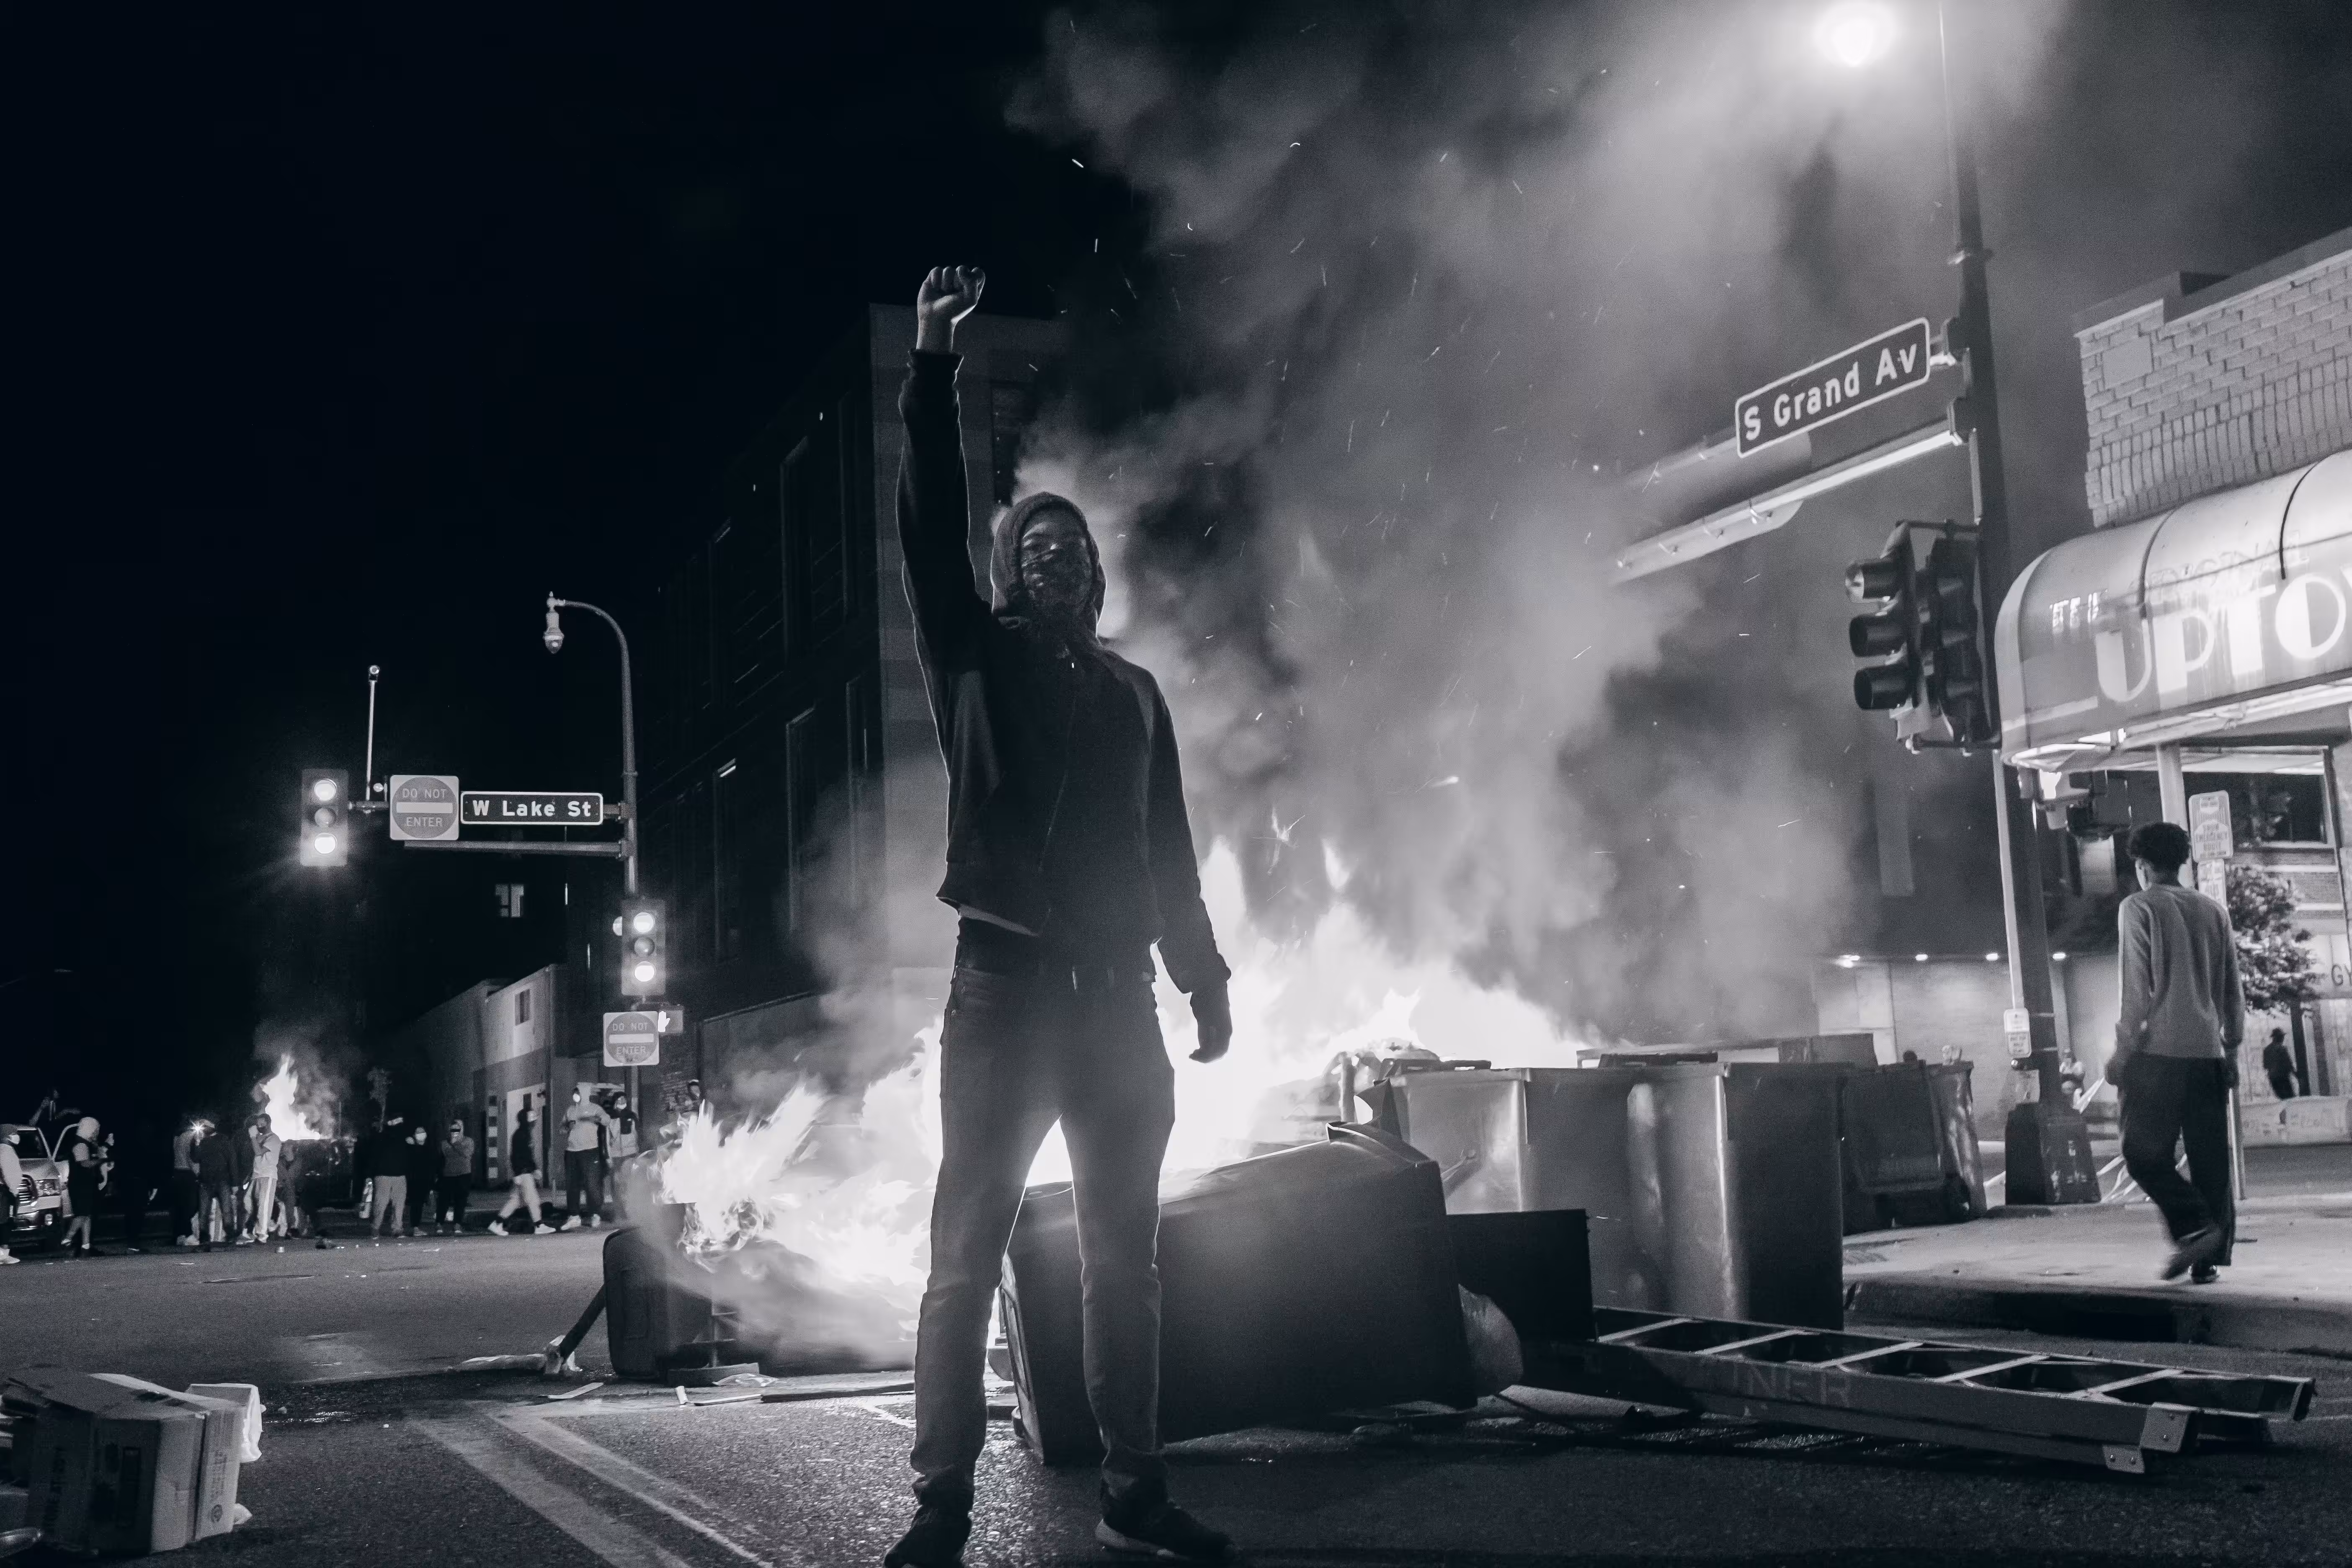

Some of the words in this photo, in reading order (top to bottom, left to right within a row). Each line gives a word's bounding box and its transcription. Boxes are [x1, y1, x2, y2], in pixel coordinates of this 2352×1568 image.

[1744, 406, 1761, 440] S
[1774, 361, 1859, 427] Grand
[1875, 343, 1917, 385] Av
[2095, 562, 2352, 710] UPTO
[402, 788, 418, 799] DO
[424, 788, 446, 799] NOT
[472, 800, 490, 816] W
[503, 800, 555, 817] Lake
[567, 801, 591, 817] St
[406, 817, 443, 827] ENTER
[613, 1023, 625, 1031] DO
[630, 1022, 648, 1031] NOT
[616, 1046, 646, 1055] ENTER
